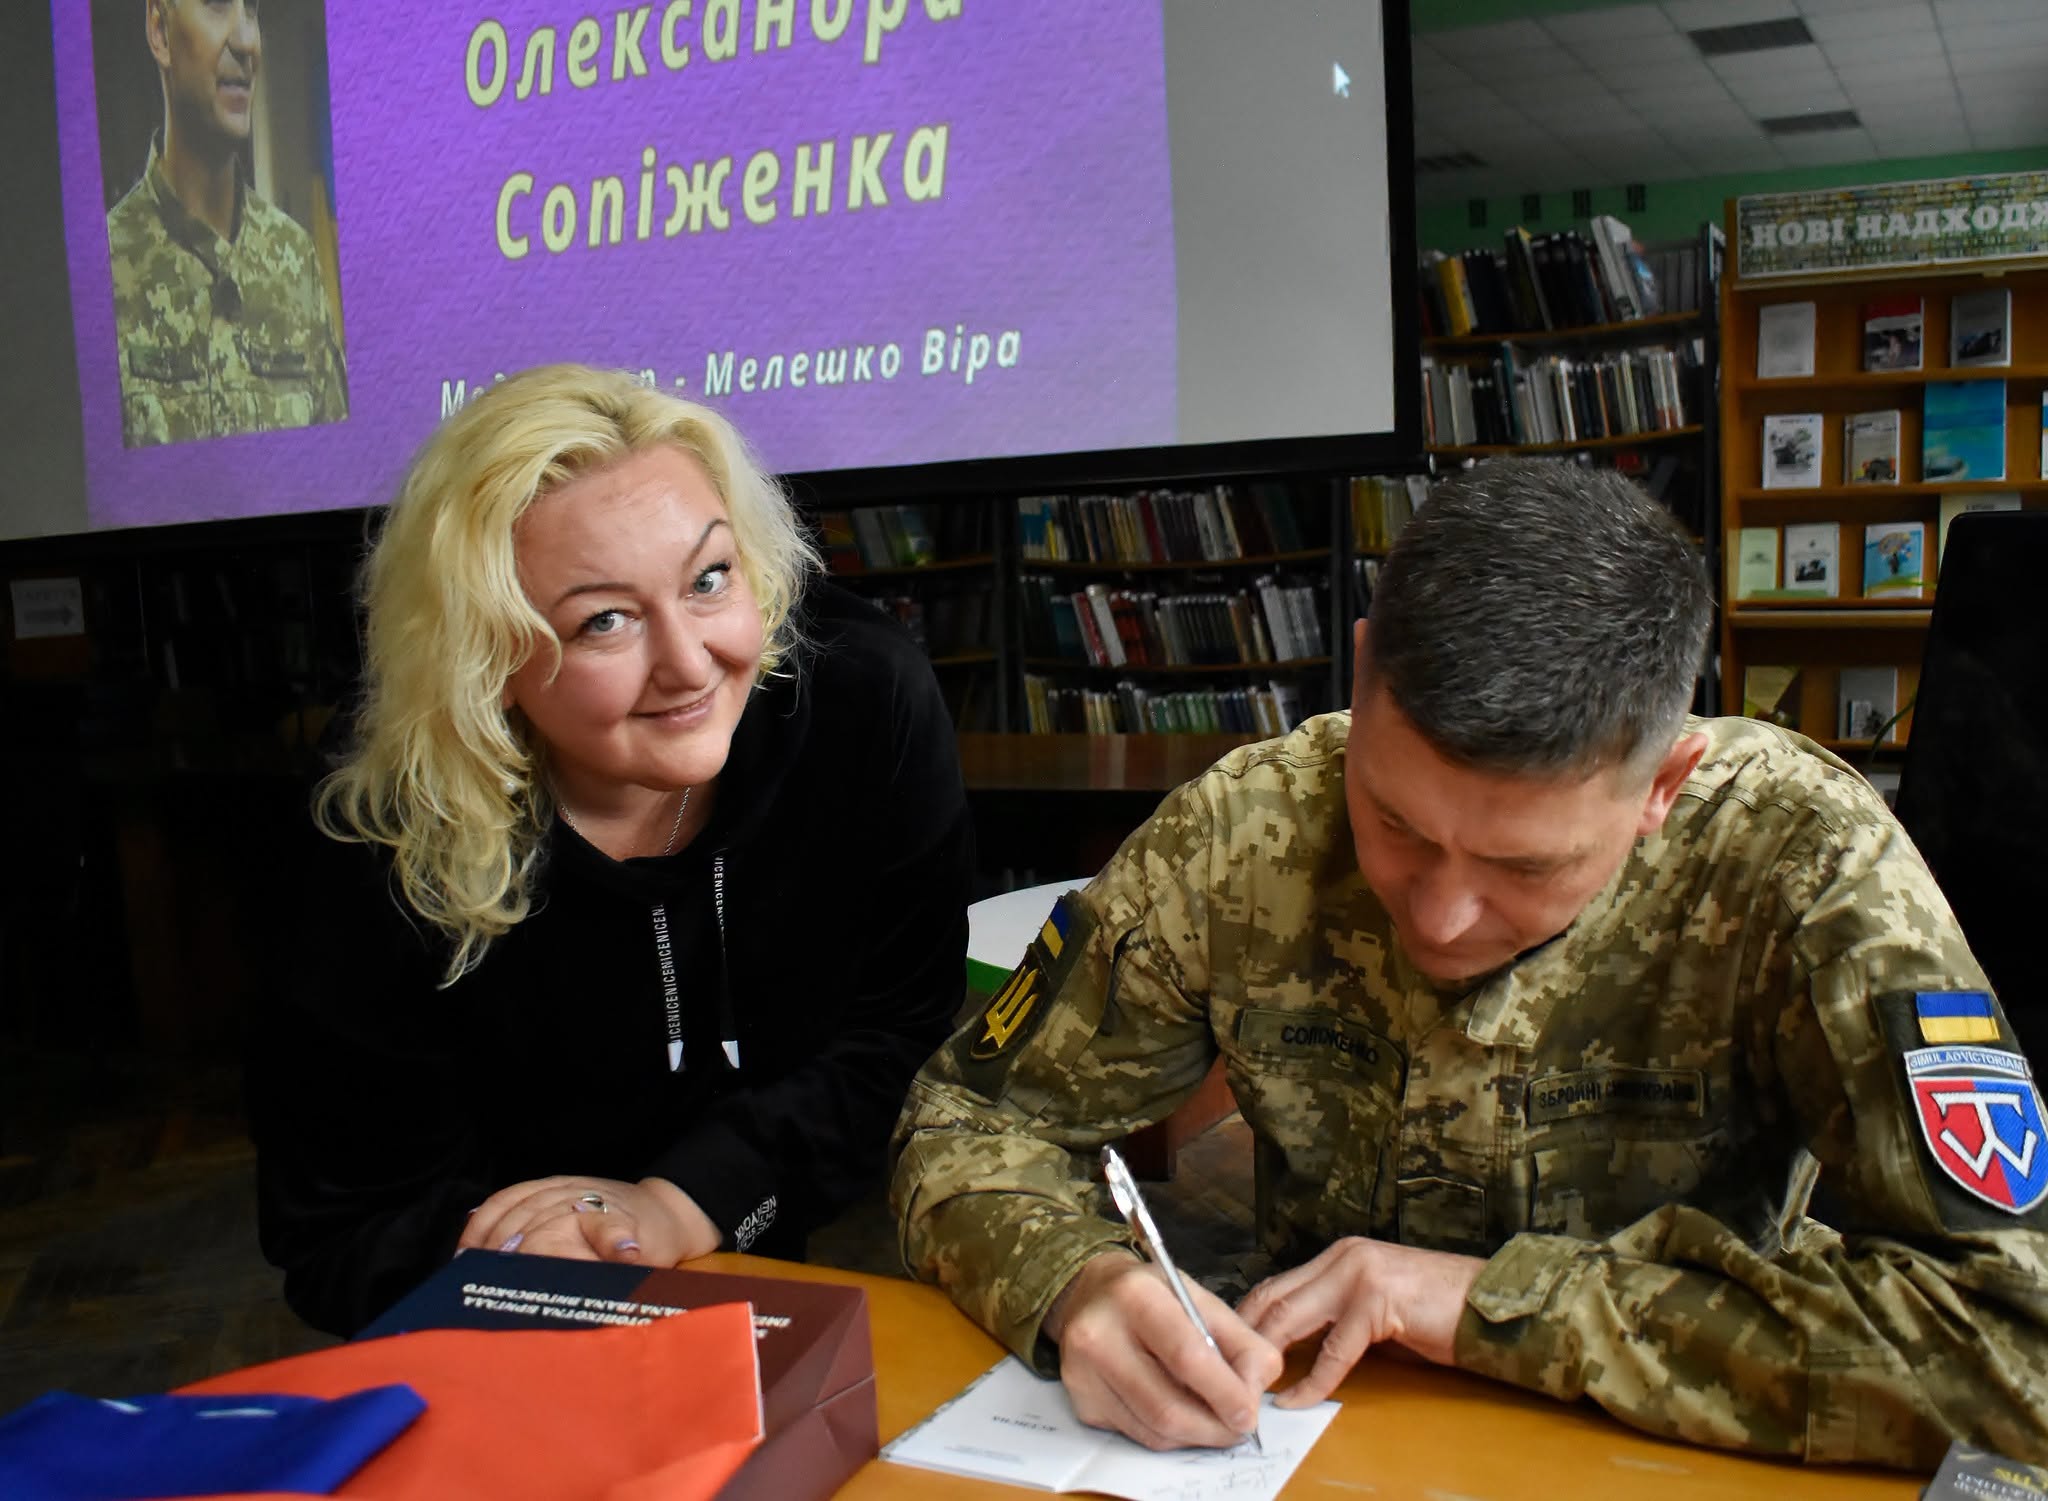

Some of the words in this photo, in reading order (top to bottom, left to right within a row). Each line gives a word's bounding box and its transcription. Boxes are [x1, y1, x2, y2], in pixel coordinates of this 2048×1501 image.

[496, 123, 949, 260] Сопіженка
[1752, 219, 1844, 247] НОВІ
[704, 341, 901, 396] Мелешко
[921, 325, 1022, 383] Віра
